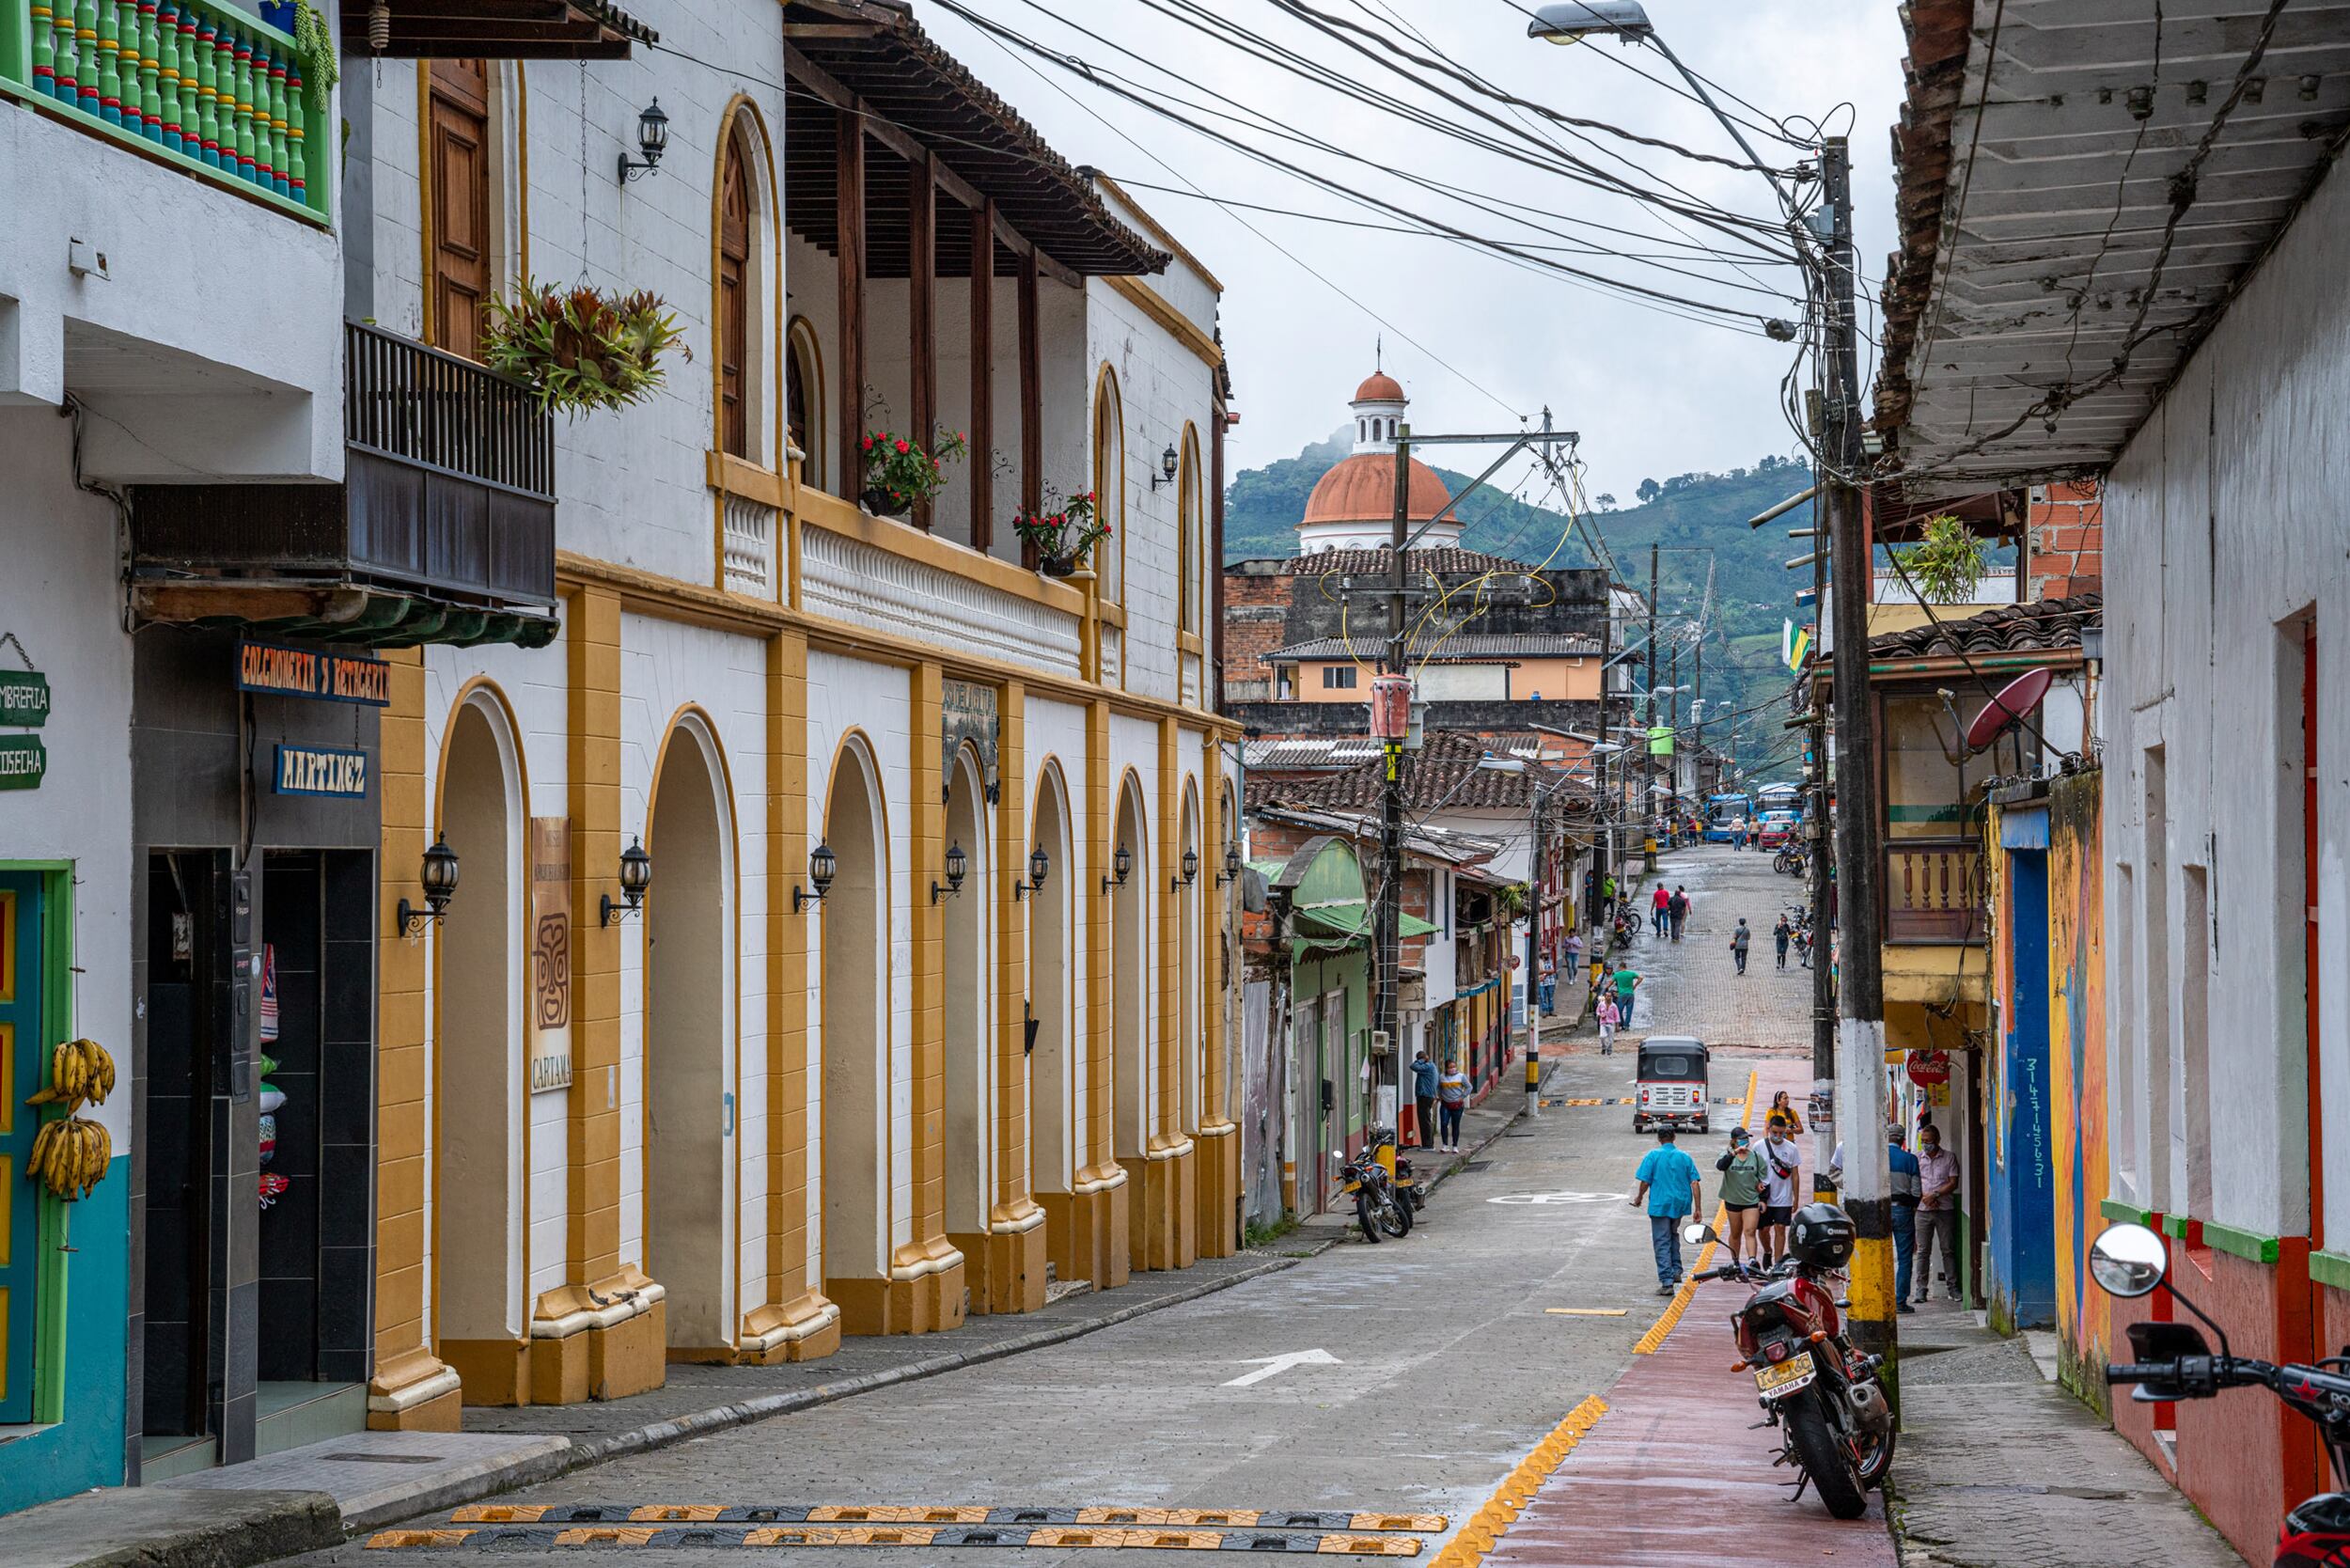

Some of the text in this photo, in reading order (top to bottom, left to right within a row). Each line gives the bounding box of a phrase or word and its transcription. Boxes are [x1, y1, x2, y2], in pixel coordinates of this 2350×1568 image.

[242, 644, 316, 693] COLCHONERIA
[0, 750, 41, 775] OSECHA
[283, 750, 365, 792] MARTINEZ
[532, 1053, 572, 1089] CARTAMA
[1768, 1380, 1799, 1397] YAMAHA
